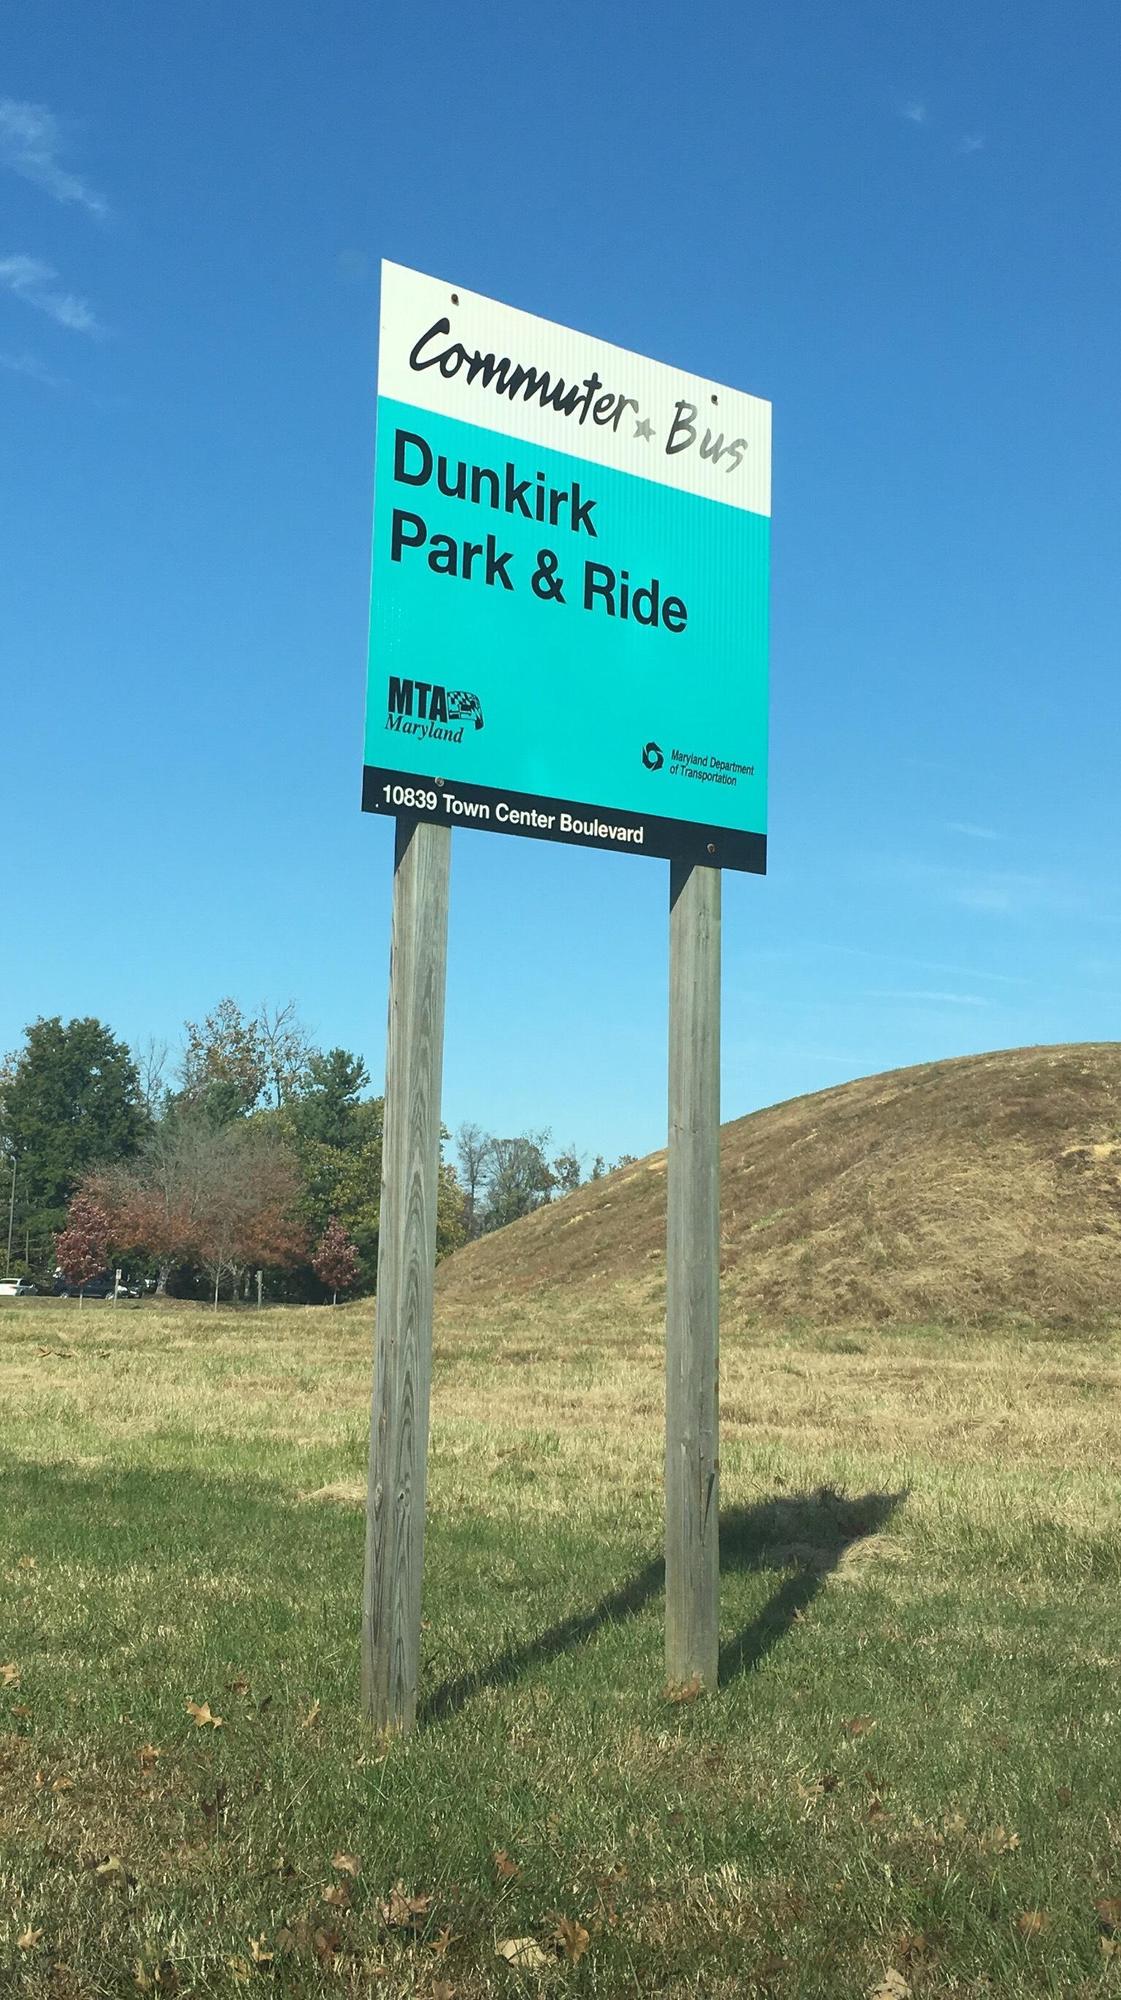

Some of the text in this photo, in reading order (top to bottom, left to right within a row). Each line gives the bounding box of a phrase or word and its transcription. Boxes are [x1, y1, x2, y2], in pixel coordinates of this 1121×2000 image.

[409, 317, 749, 473] Commuter Bus
[393, 428, 598, 538] Dunkirk
[390, 508, 689, 633] Park & Ride
[387, 675, 448, 723] MTA
[385, 713, 464, 744] Maryland
[669, 763, 737, 786] of Transportation
[671, 749, 754, 776] Maryland Department
[382, 784, 644, 844] 10839 Town Center Boulevard
